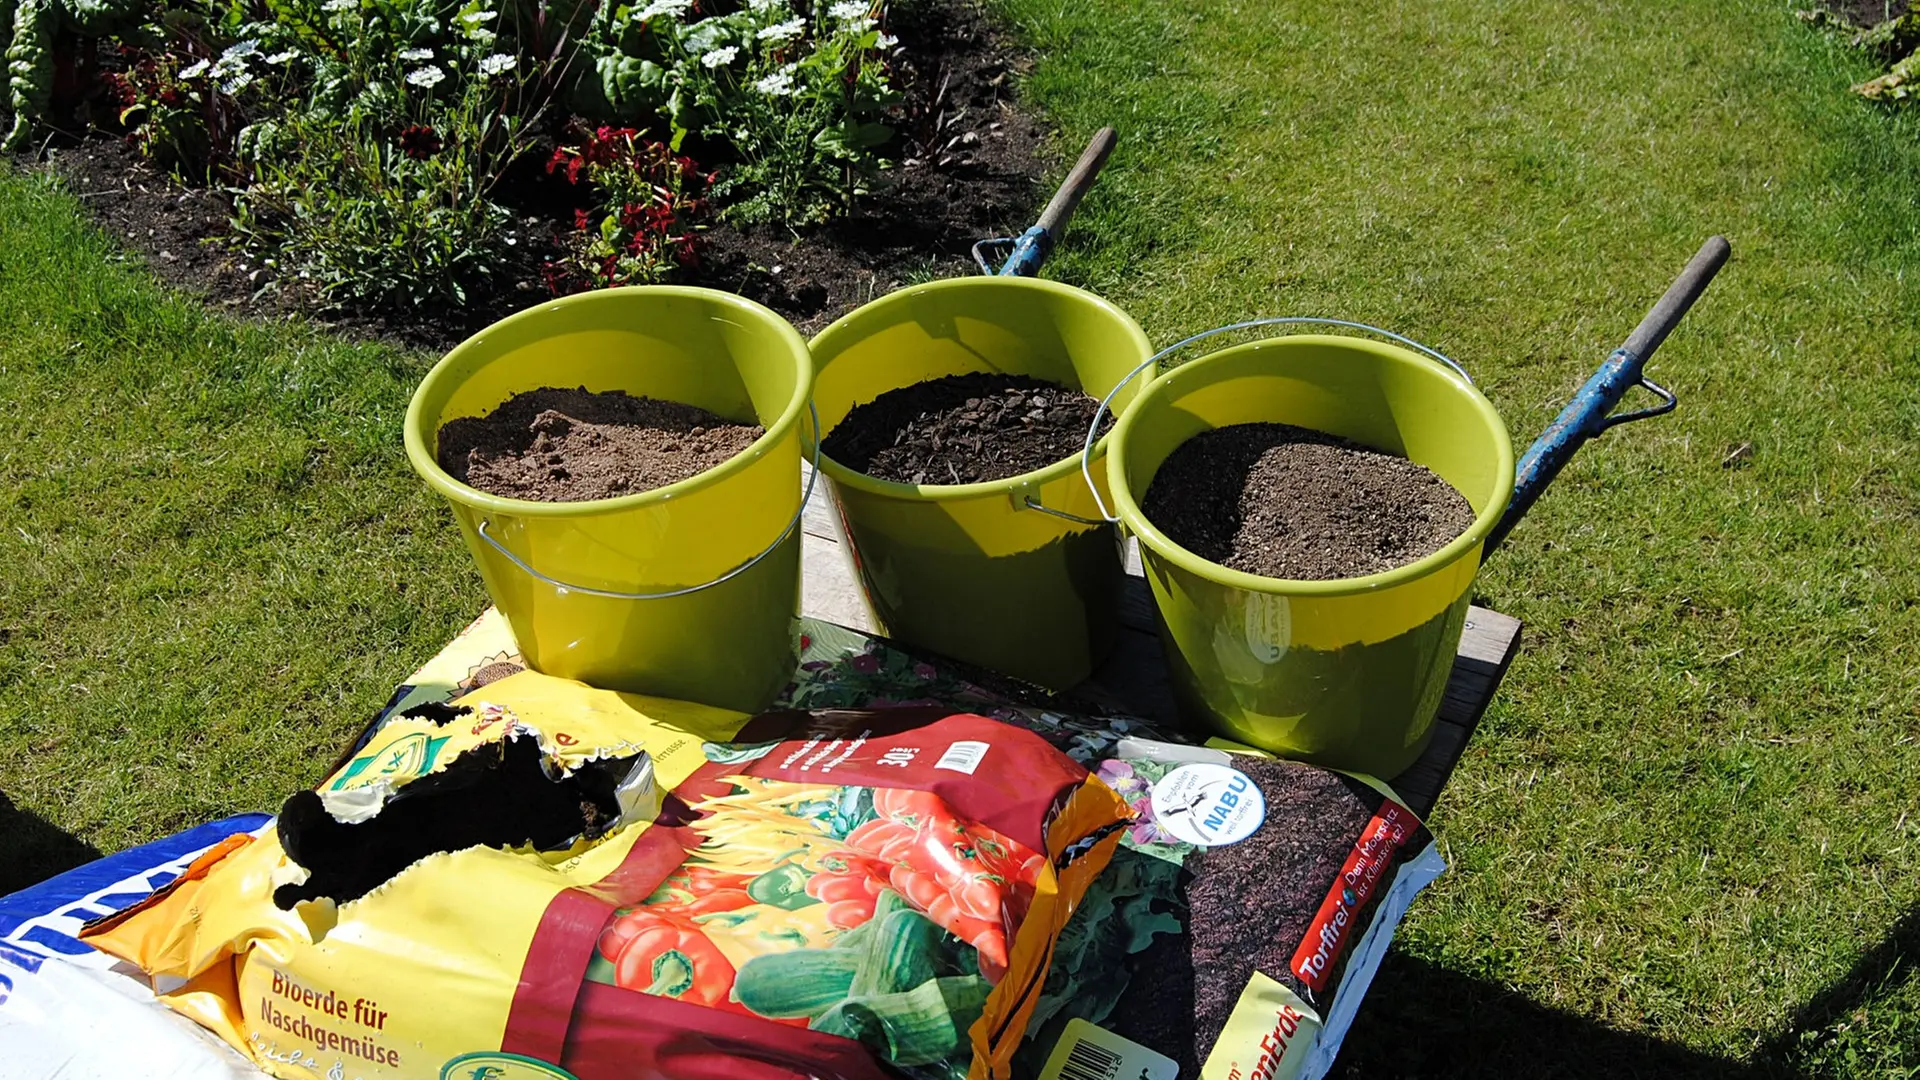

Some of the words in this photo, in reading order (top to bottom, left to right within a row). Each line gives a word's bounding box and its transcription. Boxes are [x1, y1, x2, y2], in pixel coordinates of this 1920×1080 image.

[877, 753, 915, 768] 30
[1203, 775, 1248, 831] NABU
[1299, 900, 1349, 980] Torffrei
[1344, 857, 1367, 886] Denn
[1357, 884, 1369, 898] ist
[272, 968, 348, 1020] Bioerde
[353, 998, 389, 1031] für
[261, 996, 400, 1069] Naschgemüse
